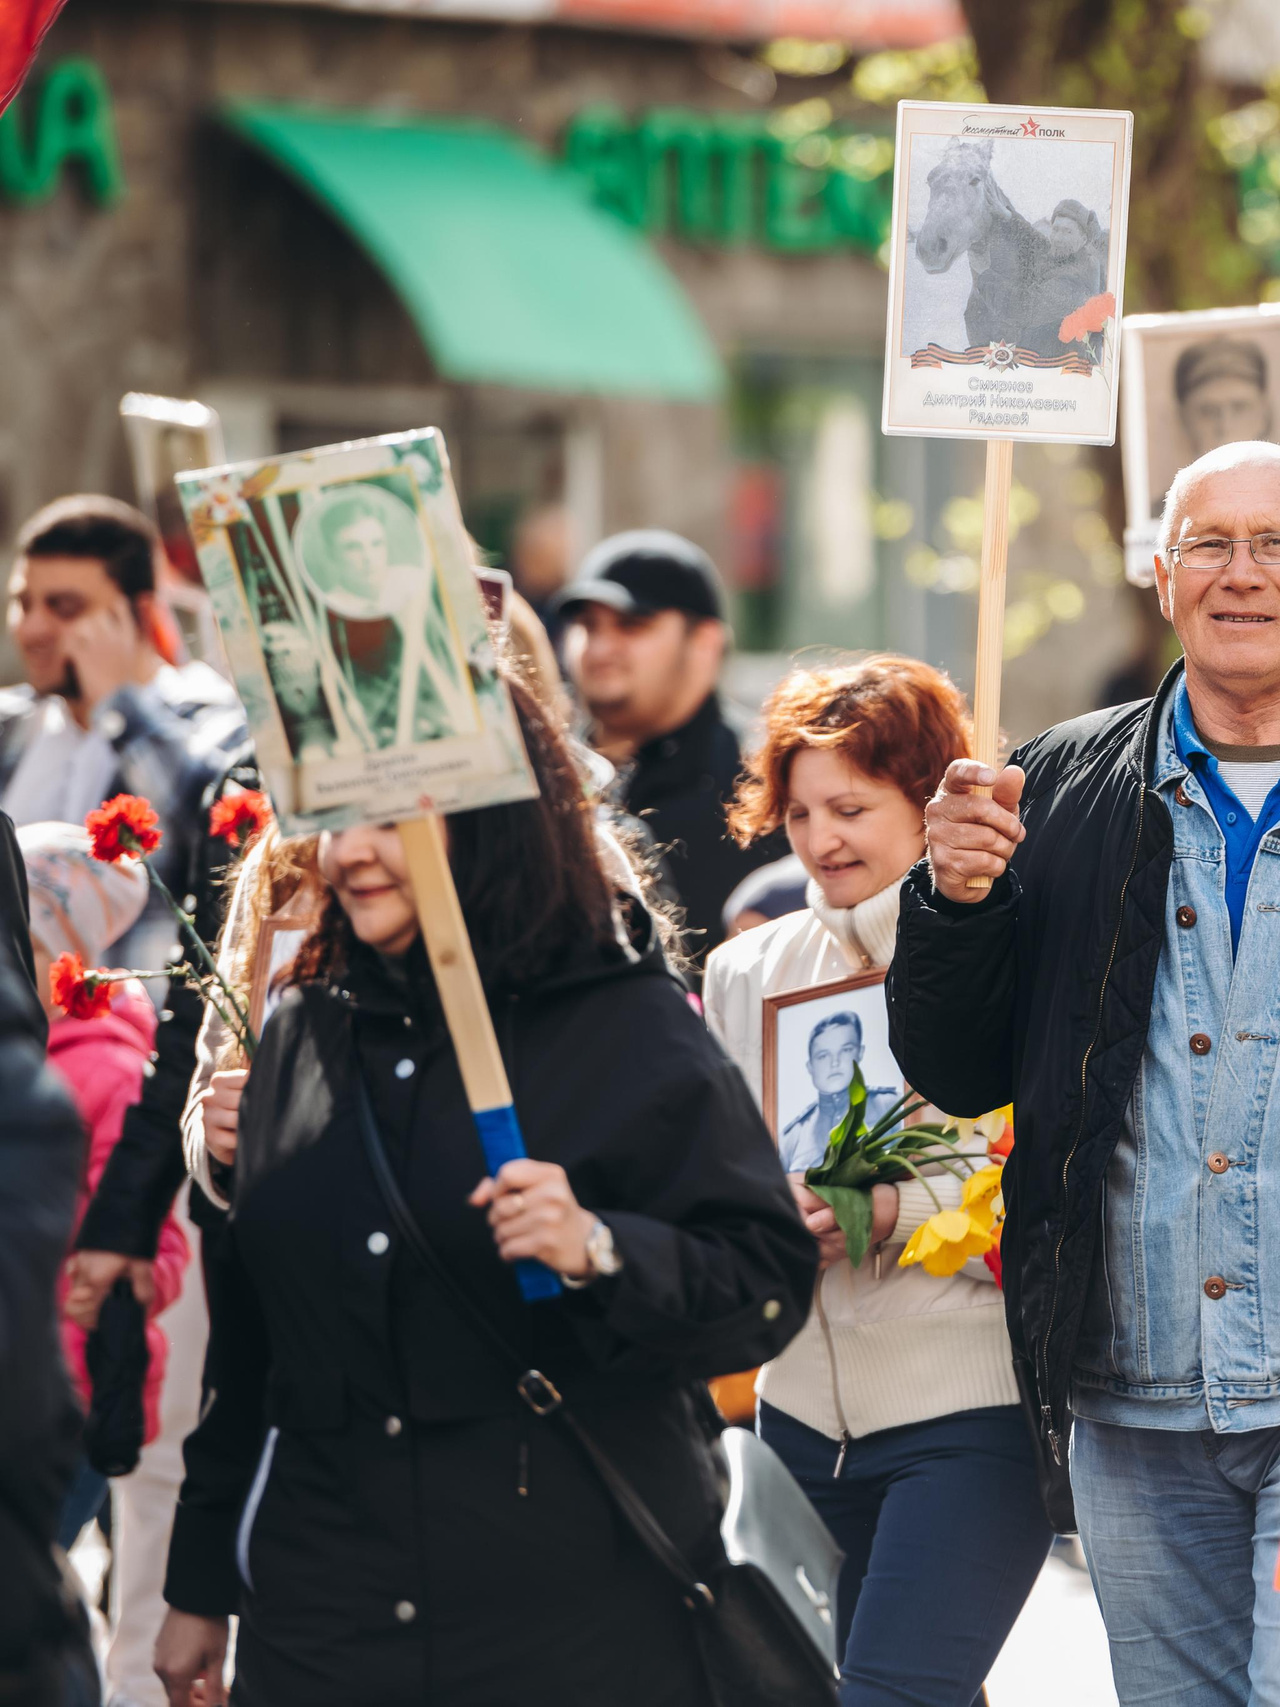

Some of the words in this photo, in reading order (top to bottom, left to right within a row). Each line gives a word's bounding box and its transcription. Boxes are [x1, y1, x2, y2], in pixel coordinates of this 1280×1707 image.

[968, 376, 1034, 393] Смирнов
[923, 391, 987, 410] Дмитрий
[990, 396, 1077, 412] Николаевич
[969, 409, 1030, 425] Рядовой
